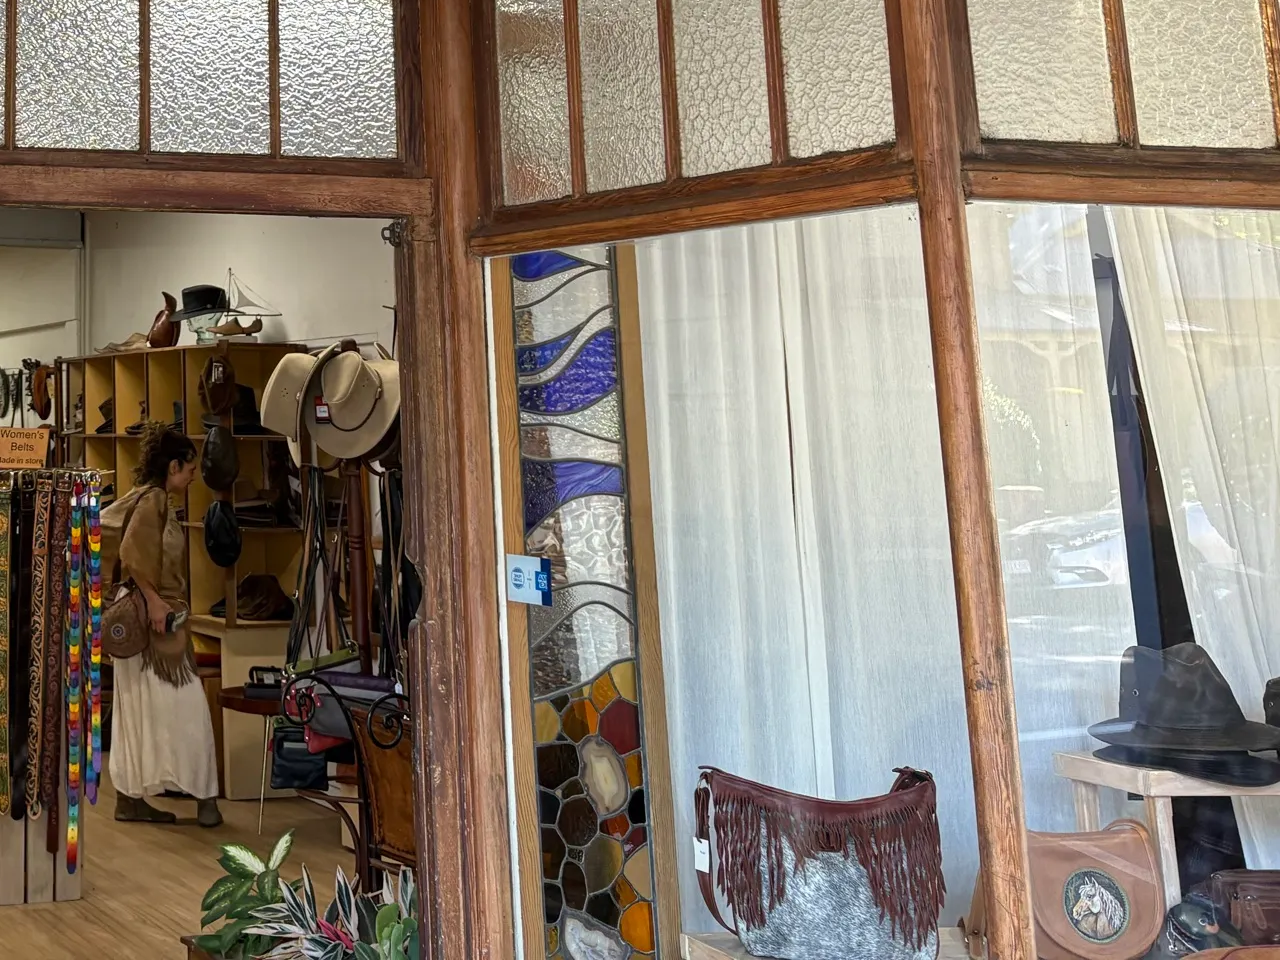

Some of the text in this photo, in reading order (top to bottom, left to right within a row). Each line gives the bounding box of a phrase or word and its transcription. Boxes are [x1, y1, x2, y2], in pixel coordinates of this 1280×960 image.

[0, 429, 45, 440] Women's
[11, 442, 35, 452] Belts
[25, 457, 44, 465] store
